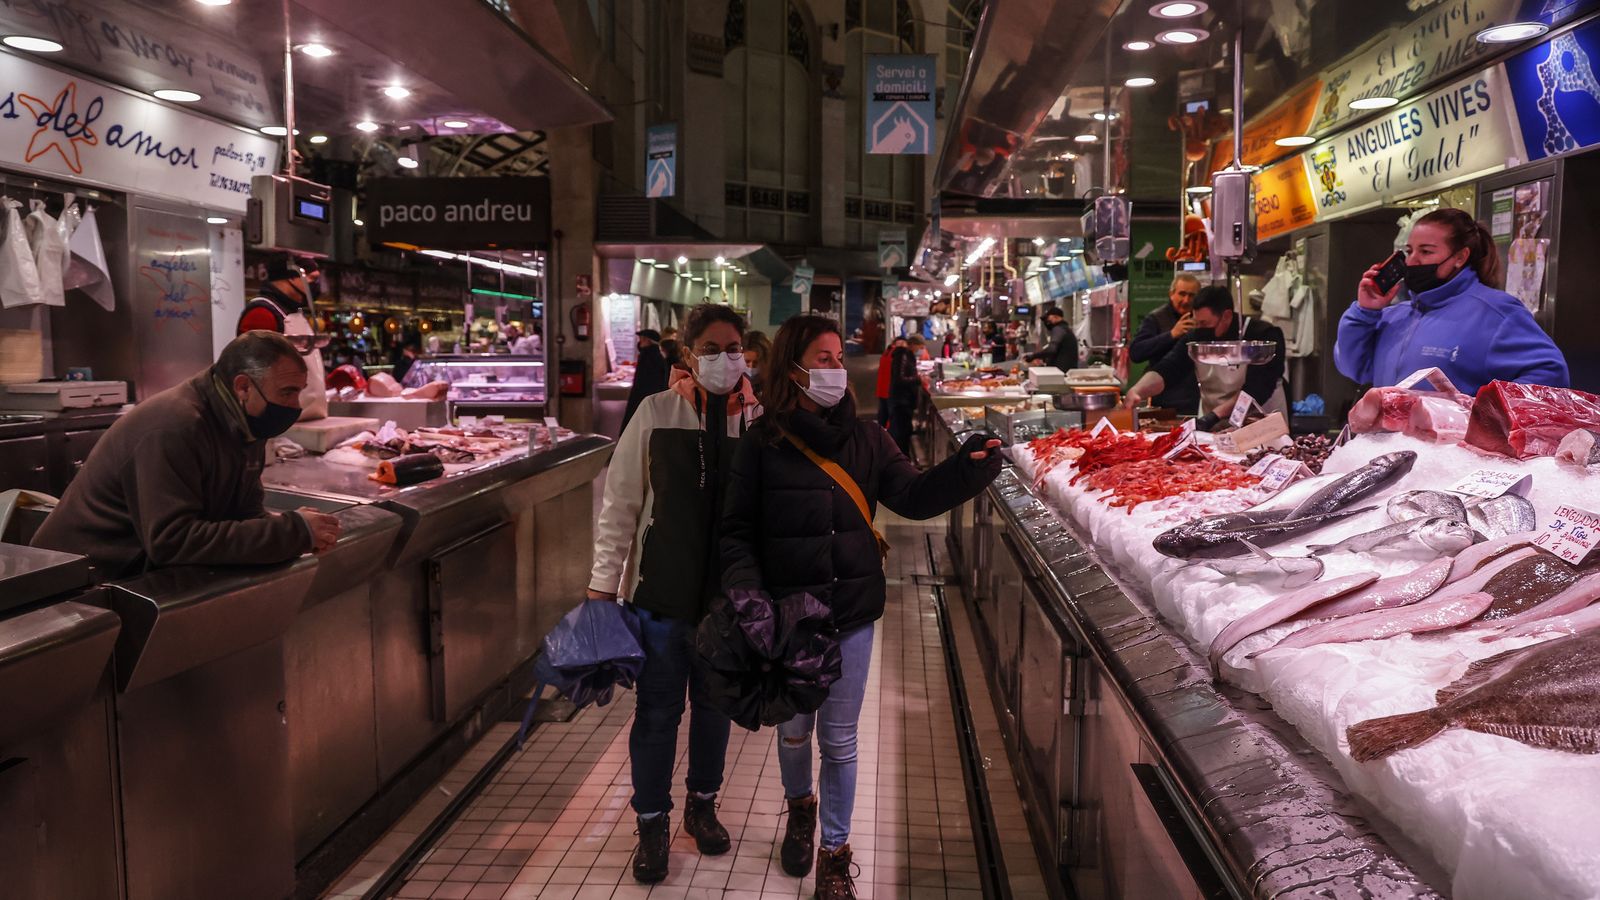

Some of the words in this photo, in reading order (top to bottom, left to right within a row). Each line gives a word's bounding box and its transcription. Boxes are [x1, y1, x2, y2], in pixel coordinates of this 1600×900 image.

[37, 90, 104, 139] del
[1348, 107, 1423, 162] ANGUILES
[1428, 79, 1491, 129] VIVES
[380, 204, 437, 227] paco
[444, 198, 532, 222] andreu
